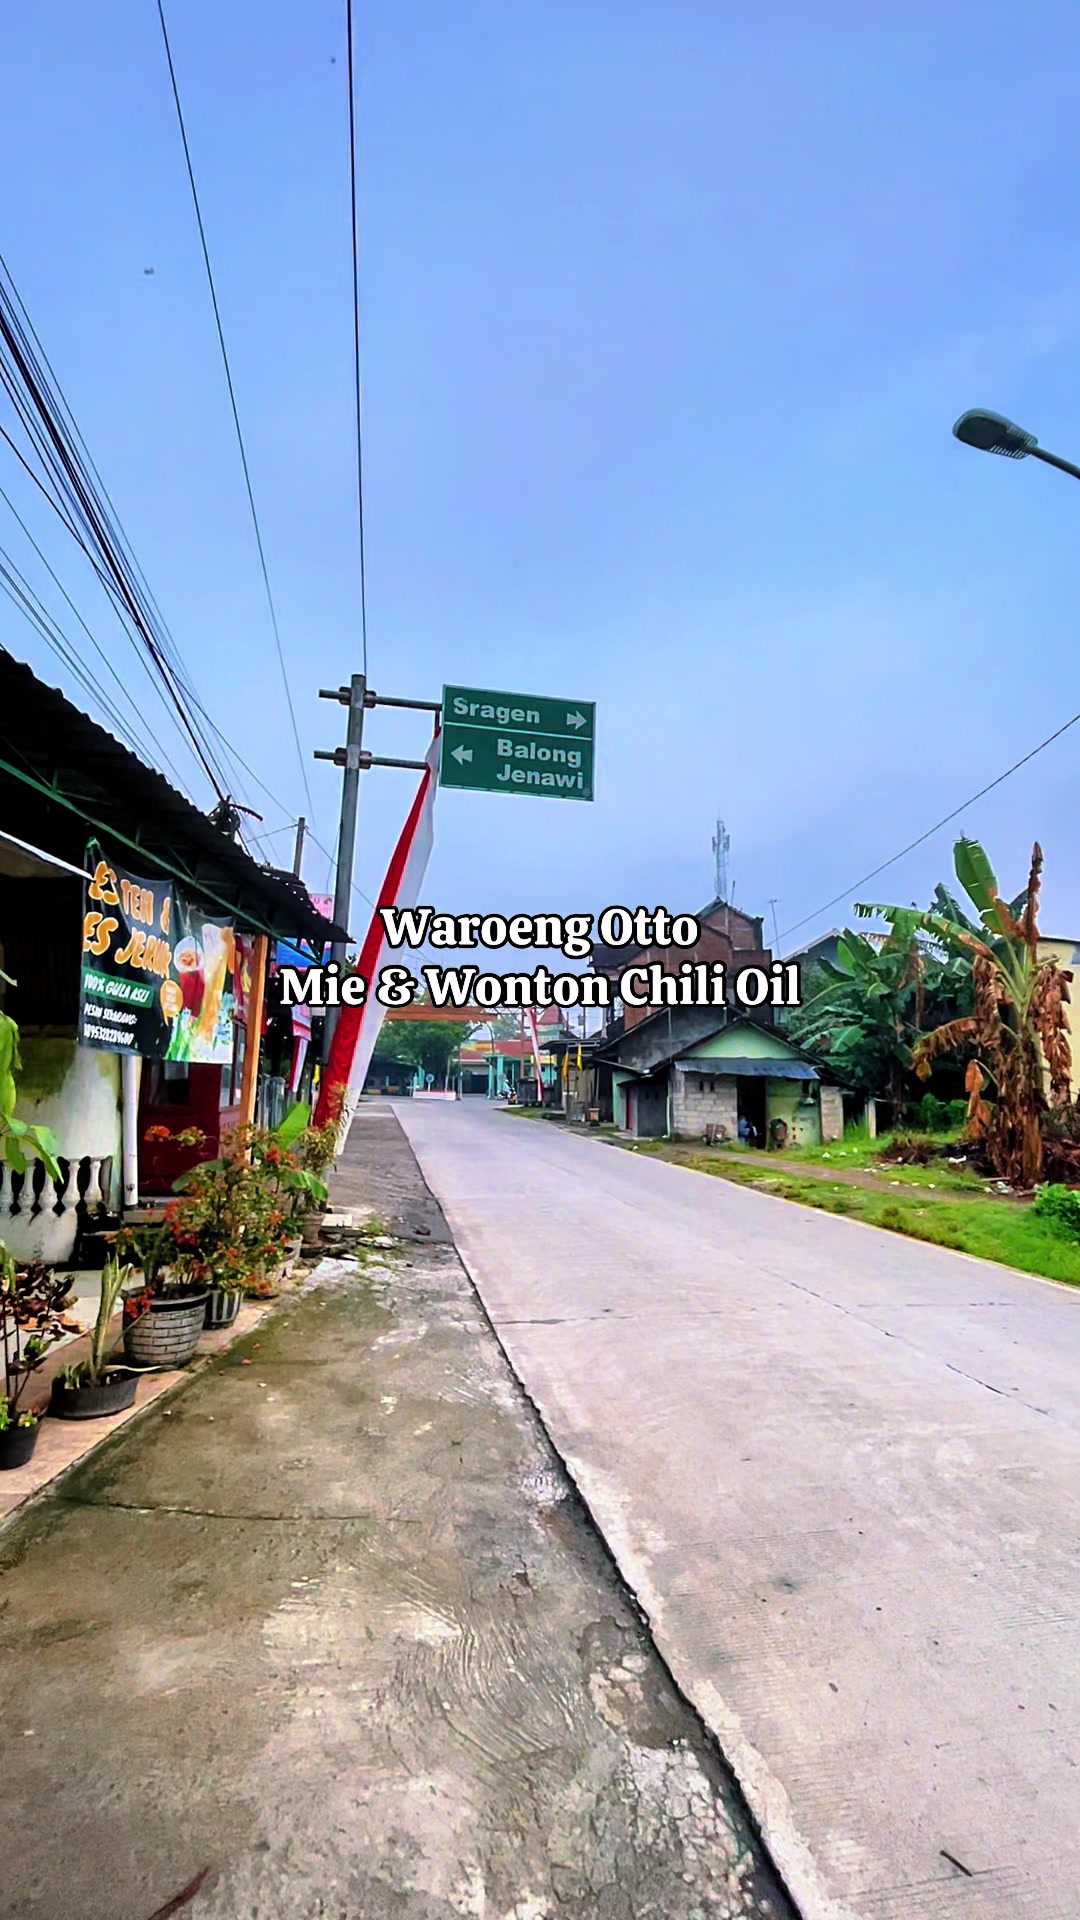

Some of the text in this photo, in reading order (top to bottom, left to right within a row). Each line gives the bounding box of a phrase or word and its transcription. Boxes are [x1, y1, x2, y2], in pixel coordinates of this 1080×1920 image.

[453, 697, 540, 724] Sragen
[497, 738, 581, 768] Balong
[496, 764, 584, 789] Jenawi
[88, 861, 120, 905] ES
[121, 879, 154, 926] TEH
[82, 911, 172, 979] ES JERUK
[83, 973, 106, 992] 100%
[105, 981, 132, 999] GULA
[130, 987, 150, 1003] ASLI
